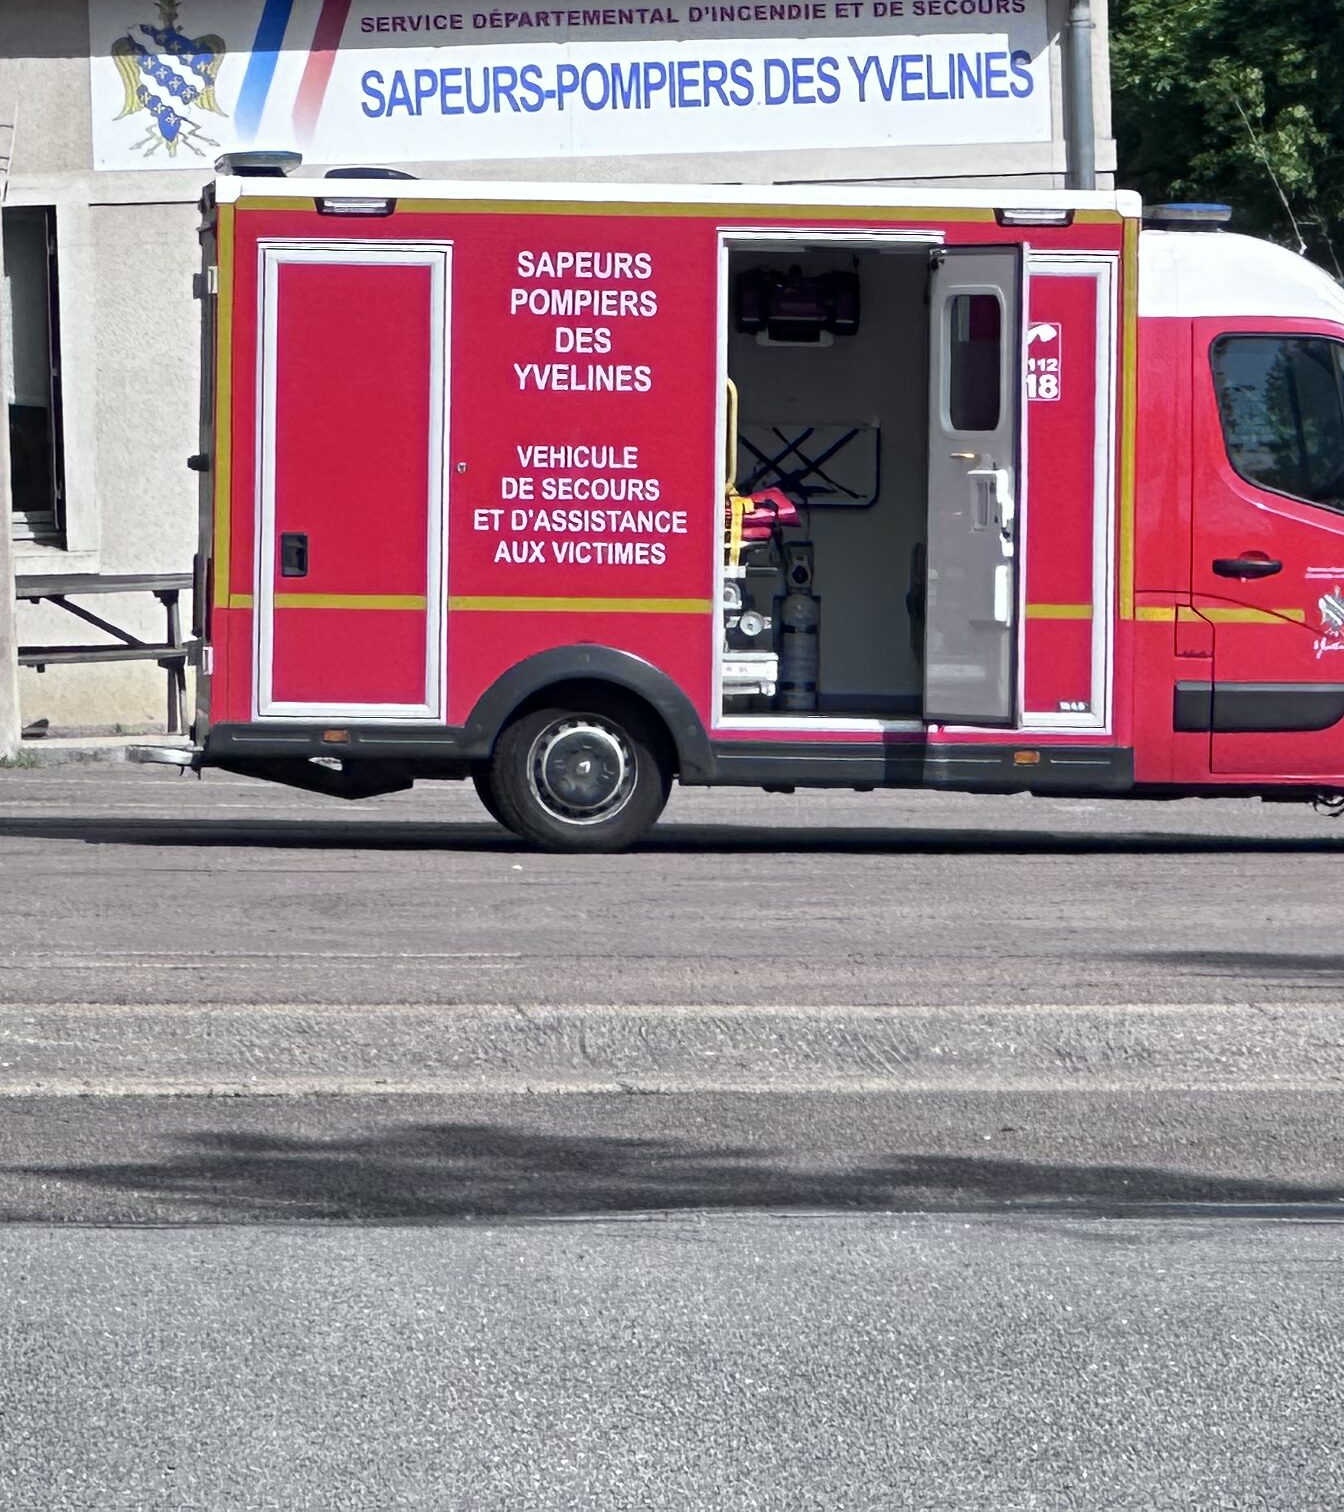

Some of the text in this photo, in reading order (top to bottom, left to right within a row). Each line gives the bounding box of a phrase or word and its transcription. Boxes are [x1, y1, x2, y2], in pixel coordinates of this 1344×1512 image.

[361, 14, 463, 33] SERVICE
[473, 7, 680, 30] DÉPARTEMENTAL
[689, 3, 827, 23] D'INCENDIE
[835, 2, 864, 19] ET
[873, 1, 904, 18] DE
[361, 49, 1034, 118] SAPEURS-POMPIERS DES YVELINES
[517, 251, 652, 280] SAPEURS
[510, 289, 658, 317] POMPIERS
[555, 327, 612, 354] DES
[513, 363, 652, 392] YVELINES
[1028, 357, 1059, 372] 112
[1027, 374, 1058, 399] 18
[517, 445, 639, 469] VEHICULE
[501, 477, 661, 501] DE SECOURS
[473, 509, 688, 534] ET D'ASSISTANCE
[494, 541, 667, 565] AUX VICTIMES
